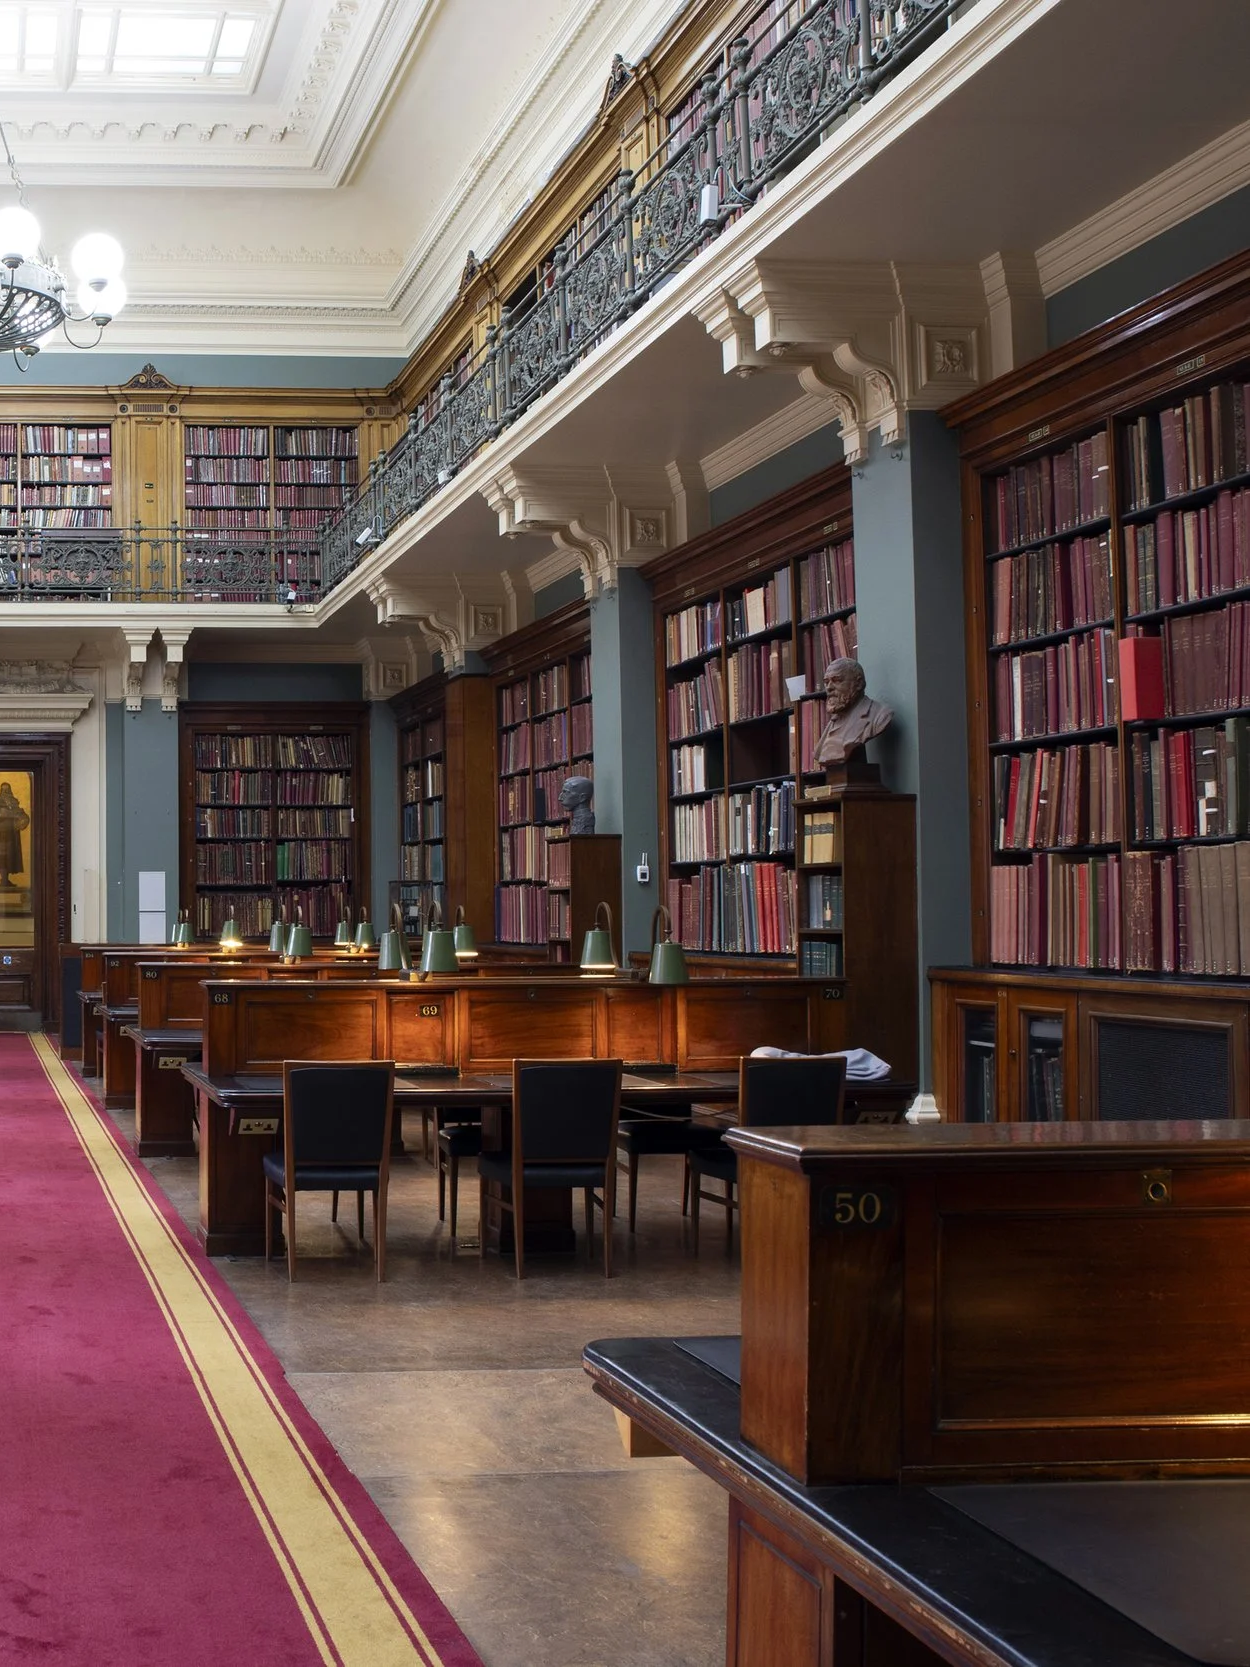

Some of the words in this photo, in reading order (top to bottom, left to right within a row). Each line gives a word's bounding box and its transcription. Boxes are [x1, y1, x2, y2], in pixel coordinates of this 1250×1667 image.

[214, 993, 229, 1004] 68
[825, 989, 840, 998] 70
[422, 1006, 438, 1016] 69
[834, 1192, 881, 1224] 50
